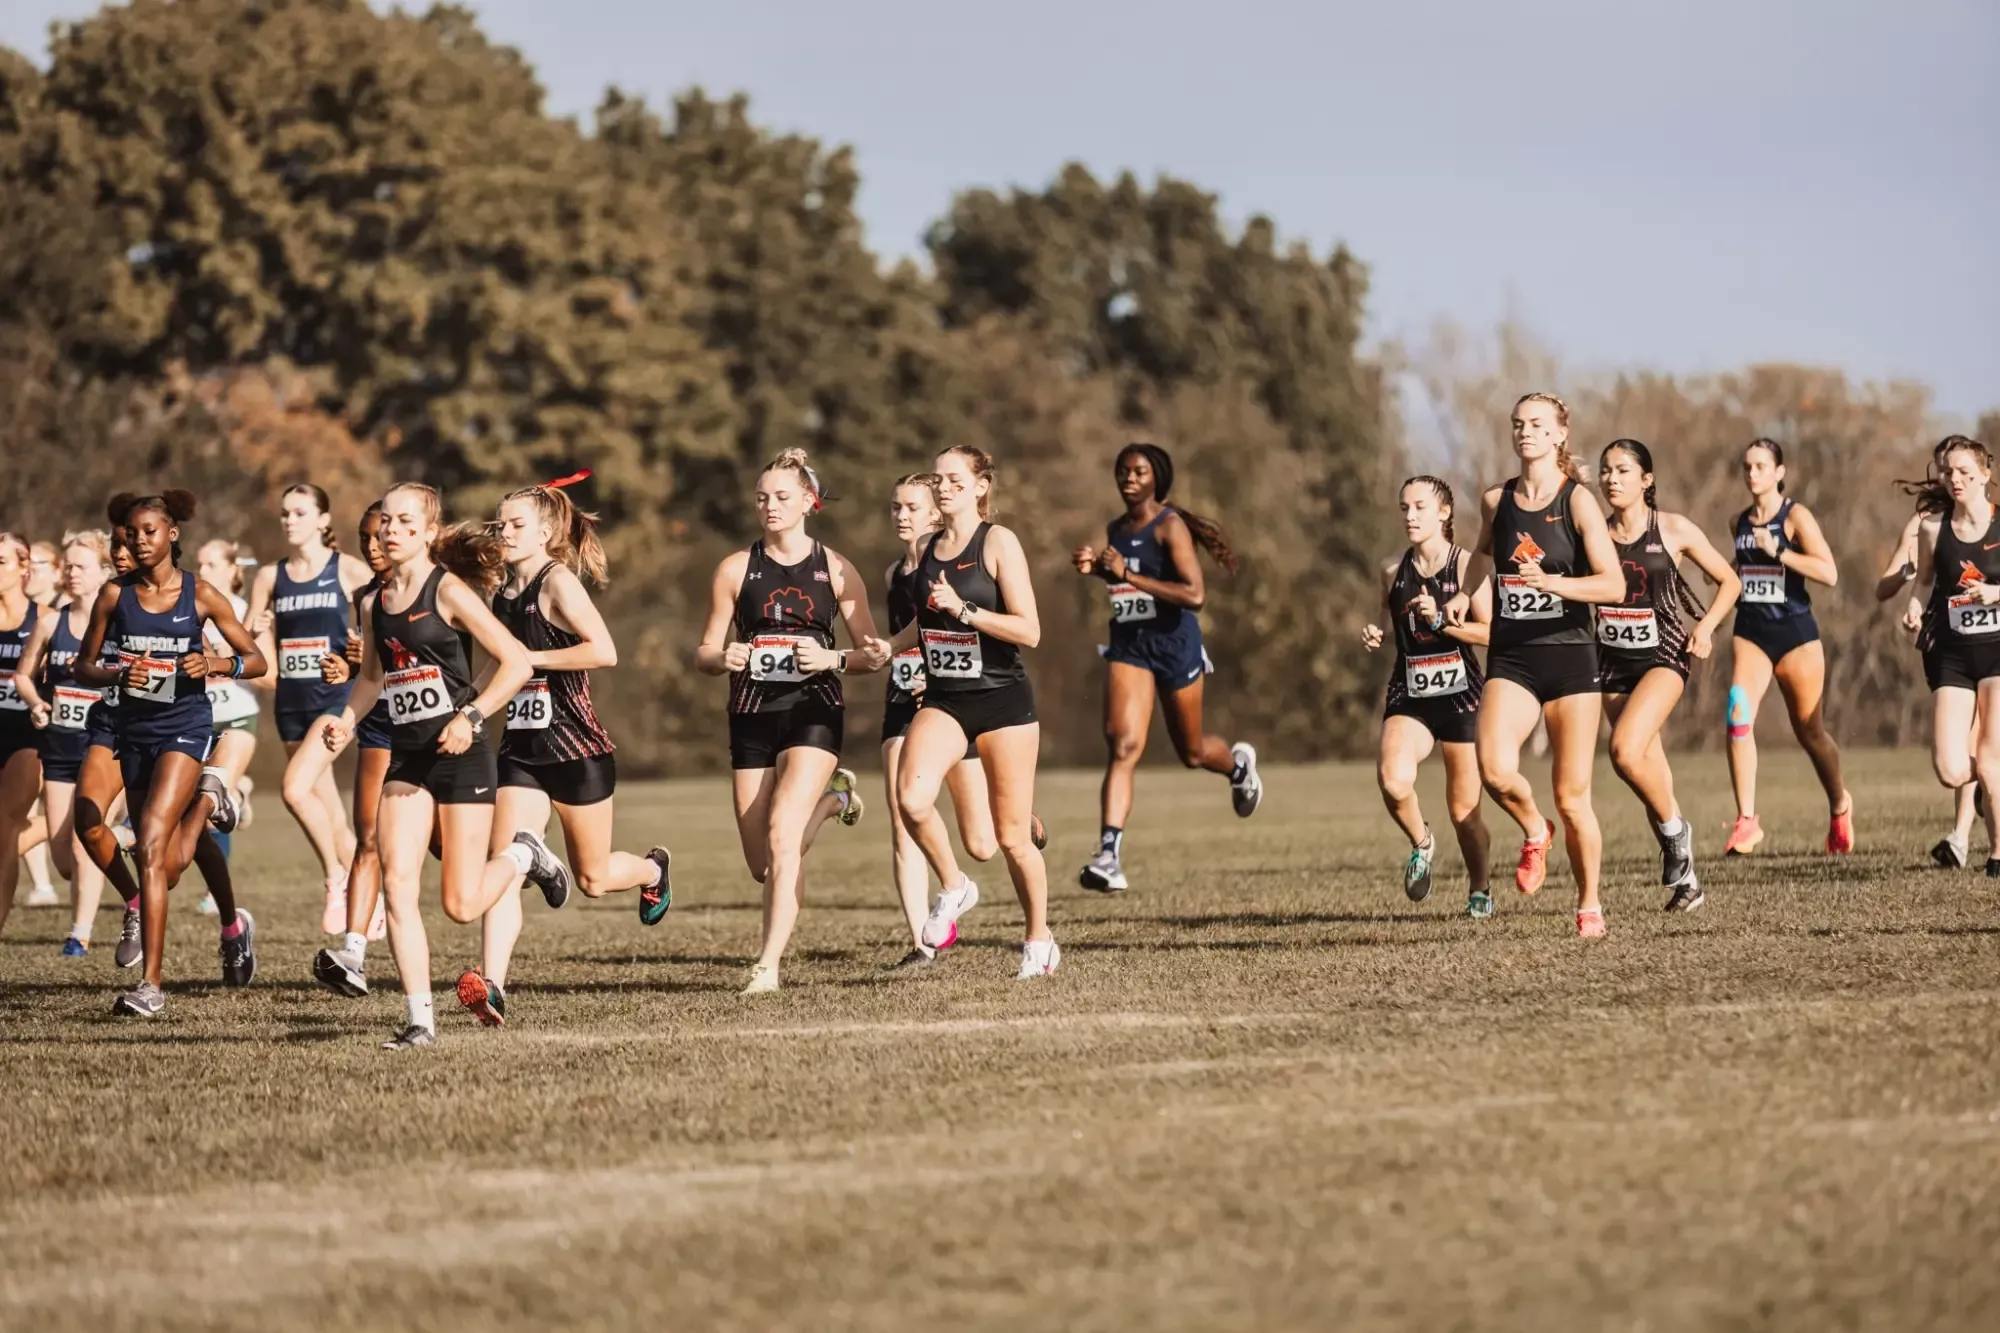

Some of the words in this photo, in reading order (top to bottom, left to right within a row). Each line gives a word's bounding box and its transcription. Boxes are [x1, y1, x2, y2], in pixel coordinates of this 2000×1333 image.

[1745, 580, 1776, 596] 851
[275, 592, 338, 612] COLUMBIA
[1113, 598, 1148, 616] 978
[1508, 593, 1554, 612] 822
[1961, 608, 1998, 627] 821
[1605, 624, 1651, 642] 943
[121, 635, 190, 653] LINCOLN
[286, 654, 321, 672] 853
[760, 653, 812, 675] 94
[930, 649, 973, 671] 823
[1414, 668, 1459, 692] 947
[393, 687, 440, 716] 820
[507, 699, 545, 721] 948
[59, 703, 85, 722] 85
